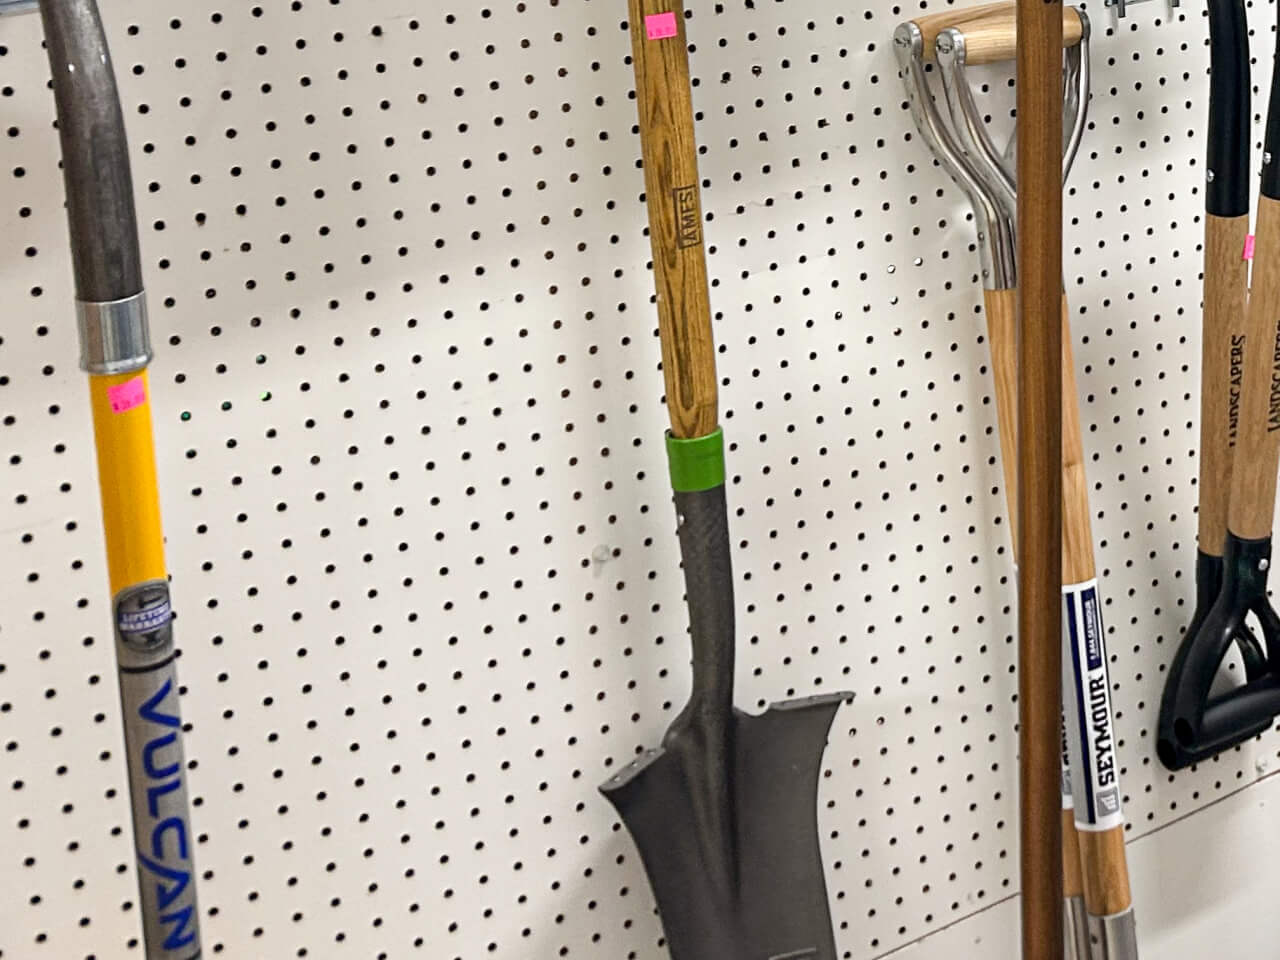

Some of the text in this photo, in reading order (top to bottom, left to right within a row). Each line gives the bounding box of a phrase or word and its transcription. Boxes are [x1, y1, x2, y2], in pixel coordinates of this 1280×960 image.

[678, 191, 698, 242] AMES
[1087, 675, 1116, 788] SEYMOUR
[137, 677, 196, 951] VULCAN
